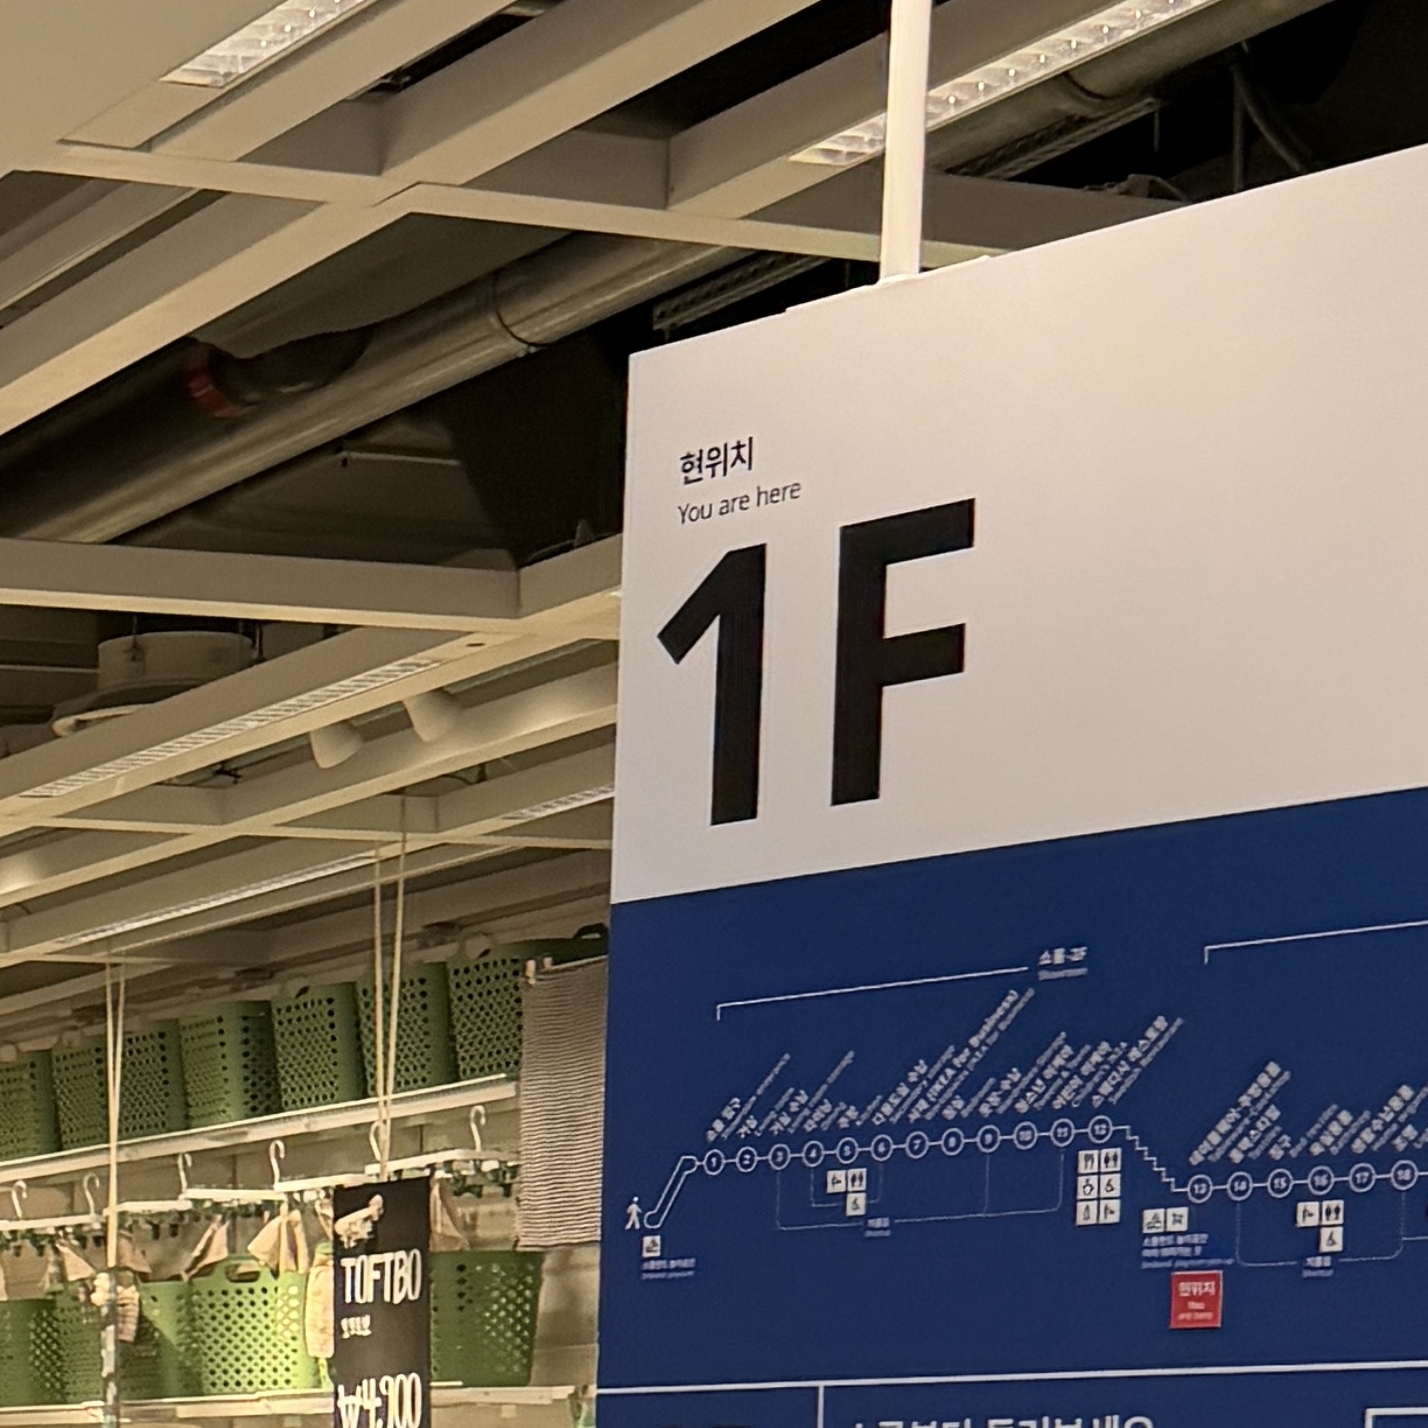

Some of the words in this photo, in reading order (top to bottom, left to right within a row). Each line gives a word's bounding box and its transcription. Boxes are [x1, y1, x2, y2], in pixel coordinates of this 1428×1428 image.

[680, 436, 753, 485] 현위치
[677, 502, 713, 525] You
[718, 493, 751, 516] are
[755, 479, 802, 506] here
[657, 495, 975, 826] 1F
